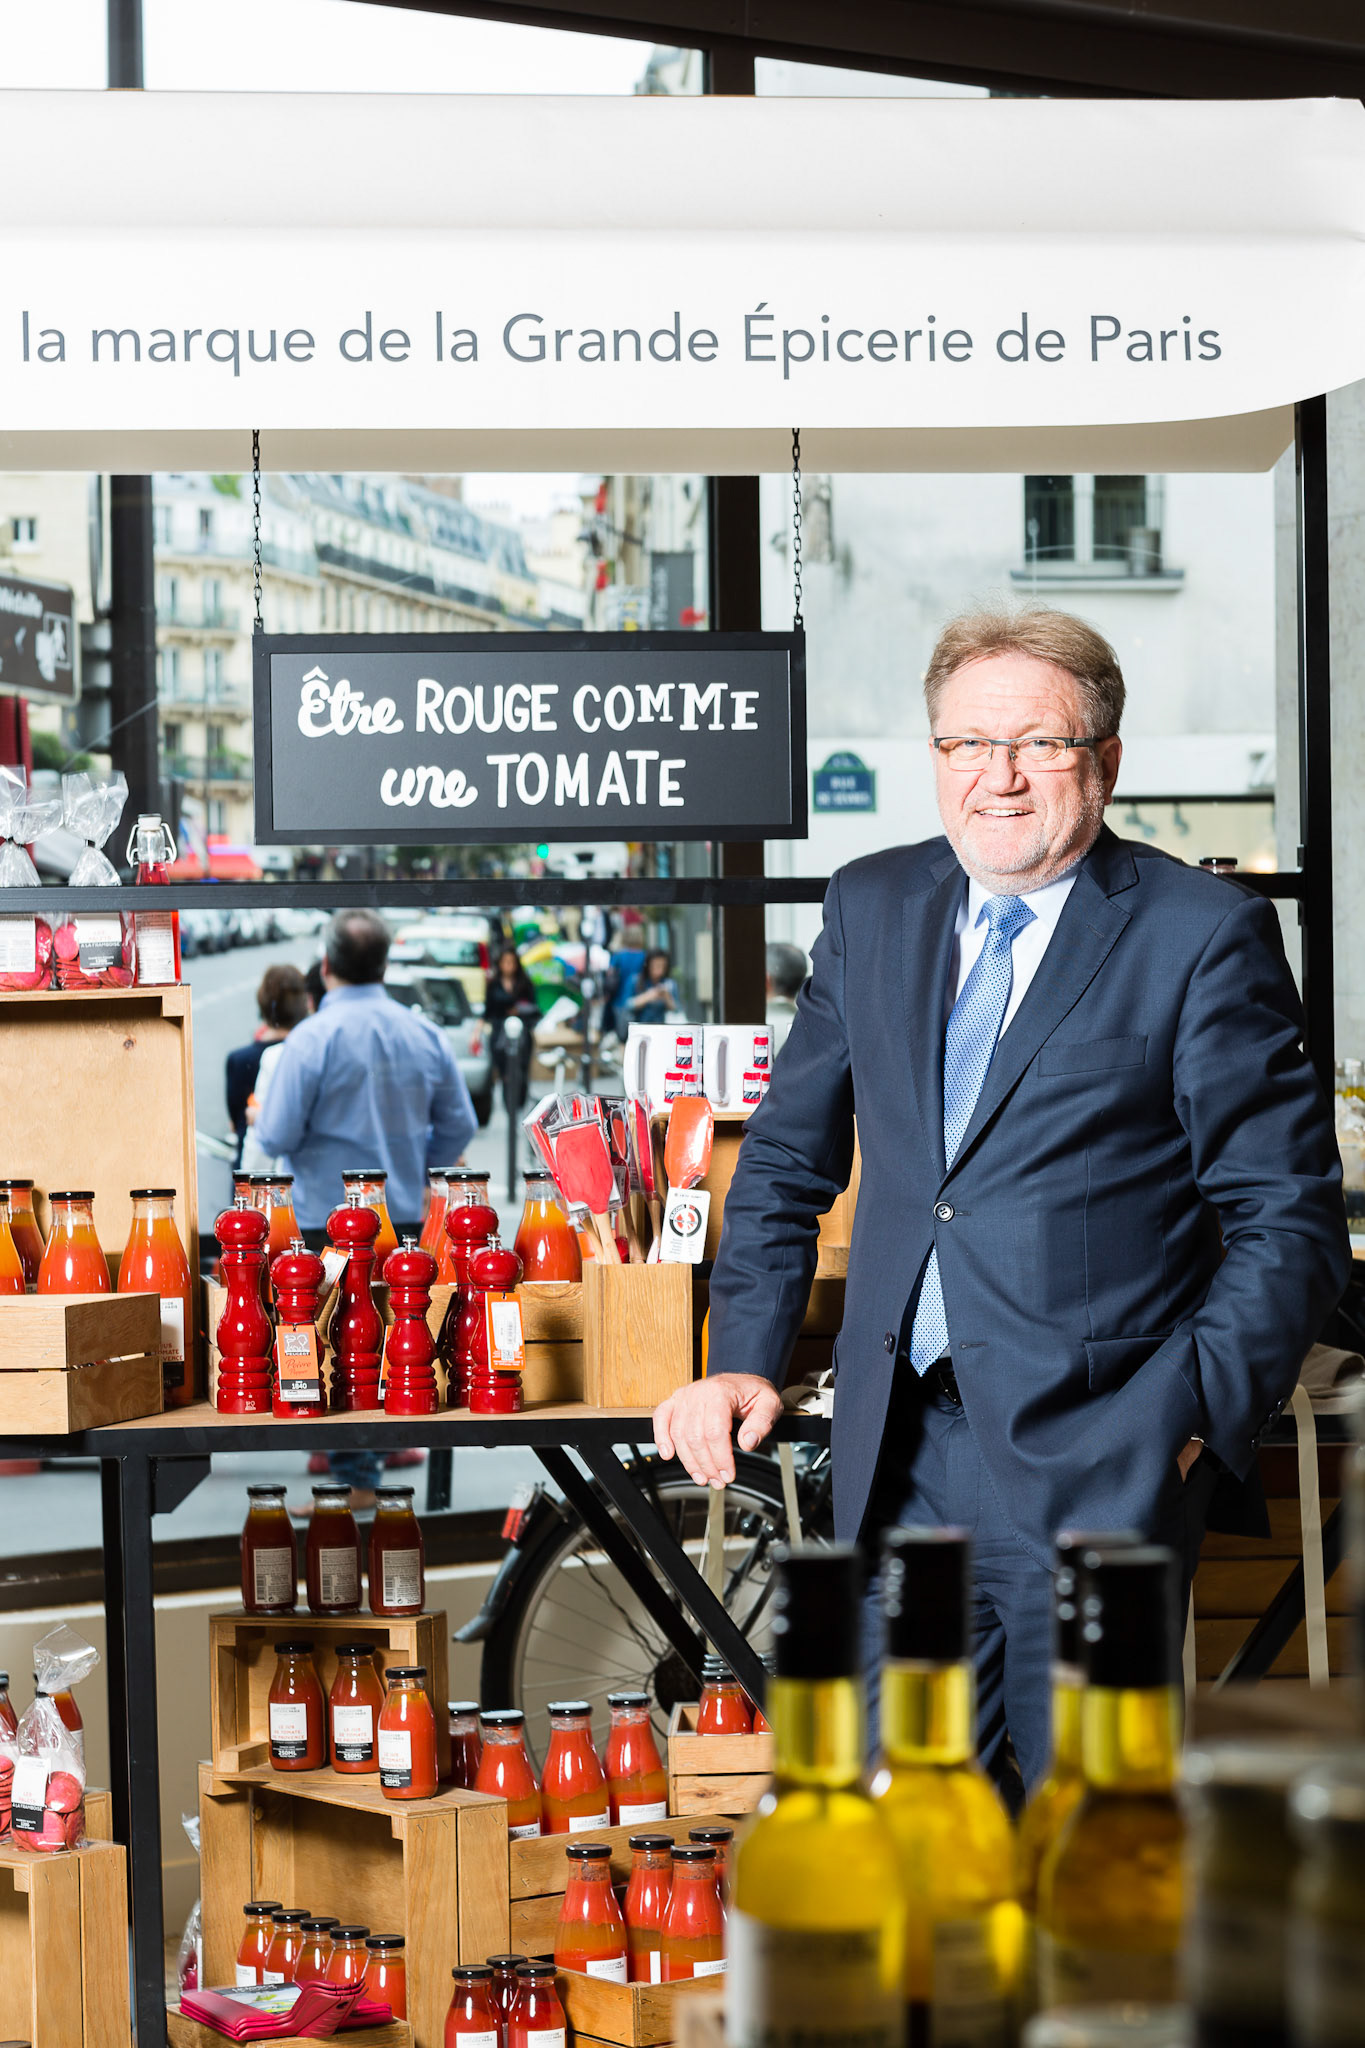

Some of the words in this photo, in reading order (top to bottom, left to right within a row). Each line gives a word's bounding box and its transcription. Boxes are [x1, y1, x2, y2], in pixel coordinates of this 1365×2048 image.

[23, 311, 65, 362] la
[92, 329, 315, 376] marque
[340, 311, 410, 362] de
[436, 311, 477, 362] la
[503, 312, 718, 362] Grande
[745, 303, 973, 379] Épicerie
[997, 312, 1065, 362] de
[1091, 315, 1221, 362] Paris
[297, 666, 404, 738] Être
[416, 678, 558, 734] ROUGE
[573, 683, 759, 733] COMME
[380, 765, 478, 808] une
[486, 750, 686, 808] TOMATE
